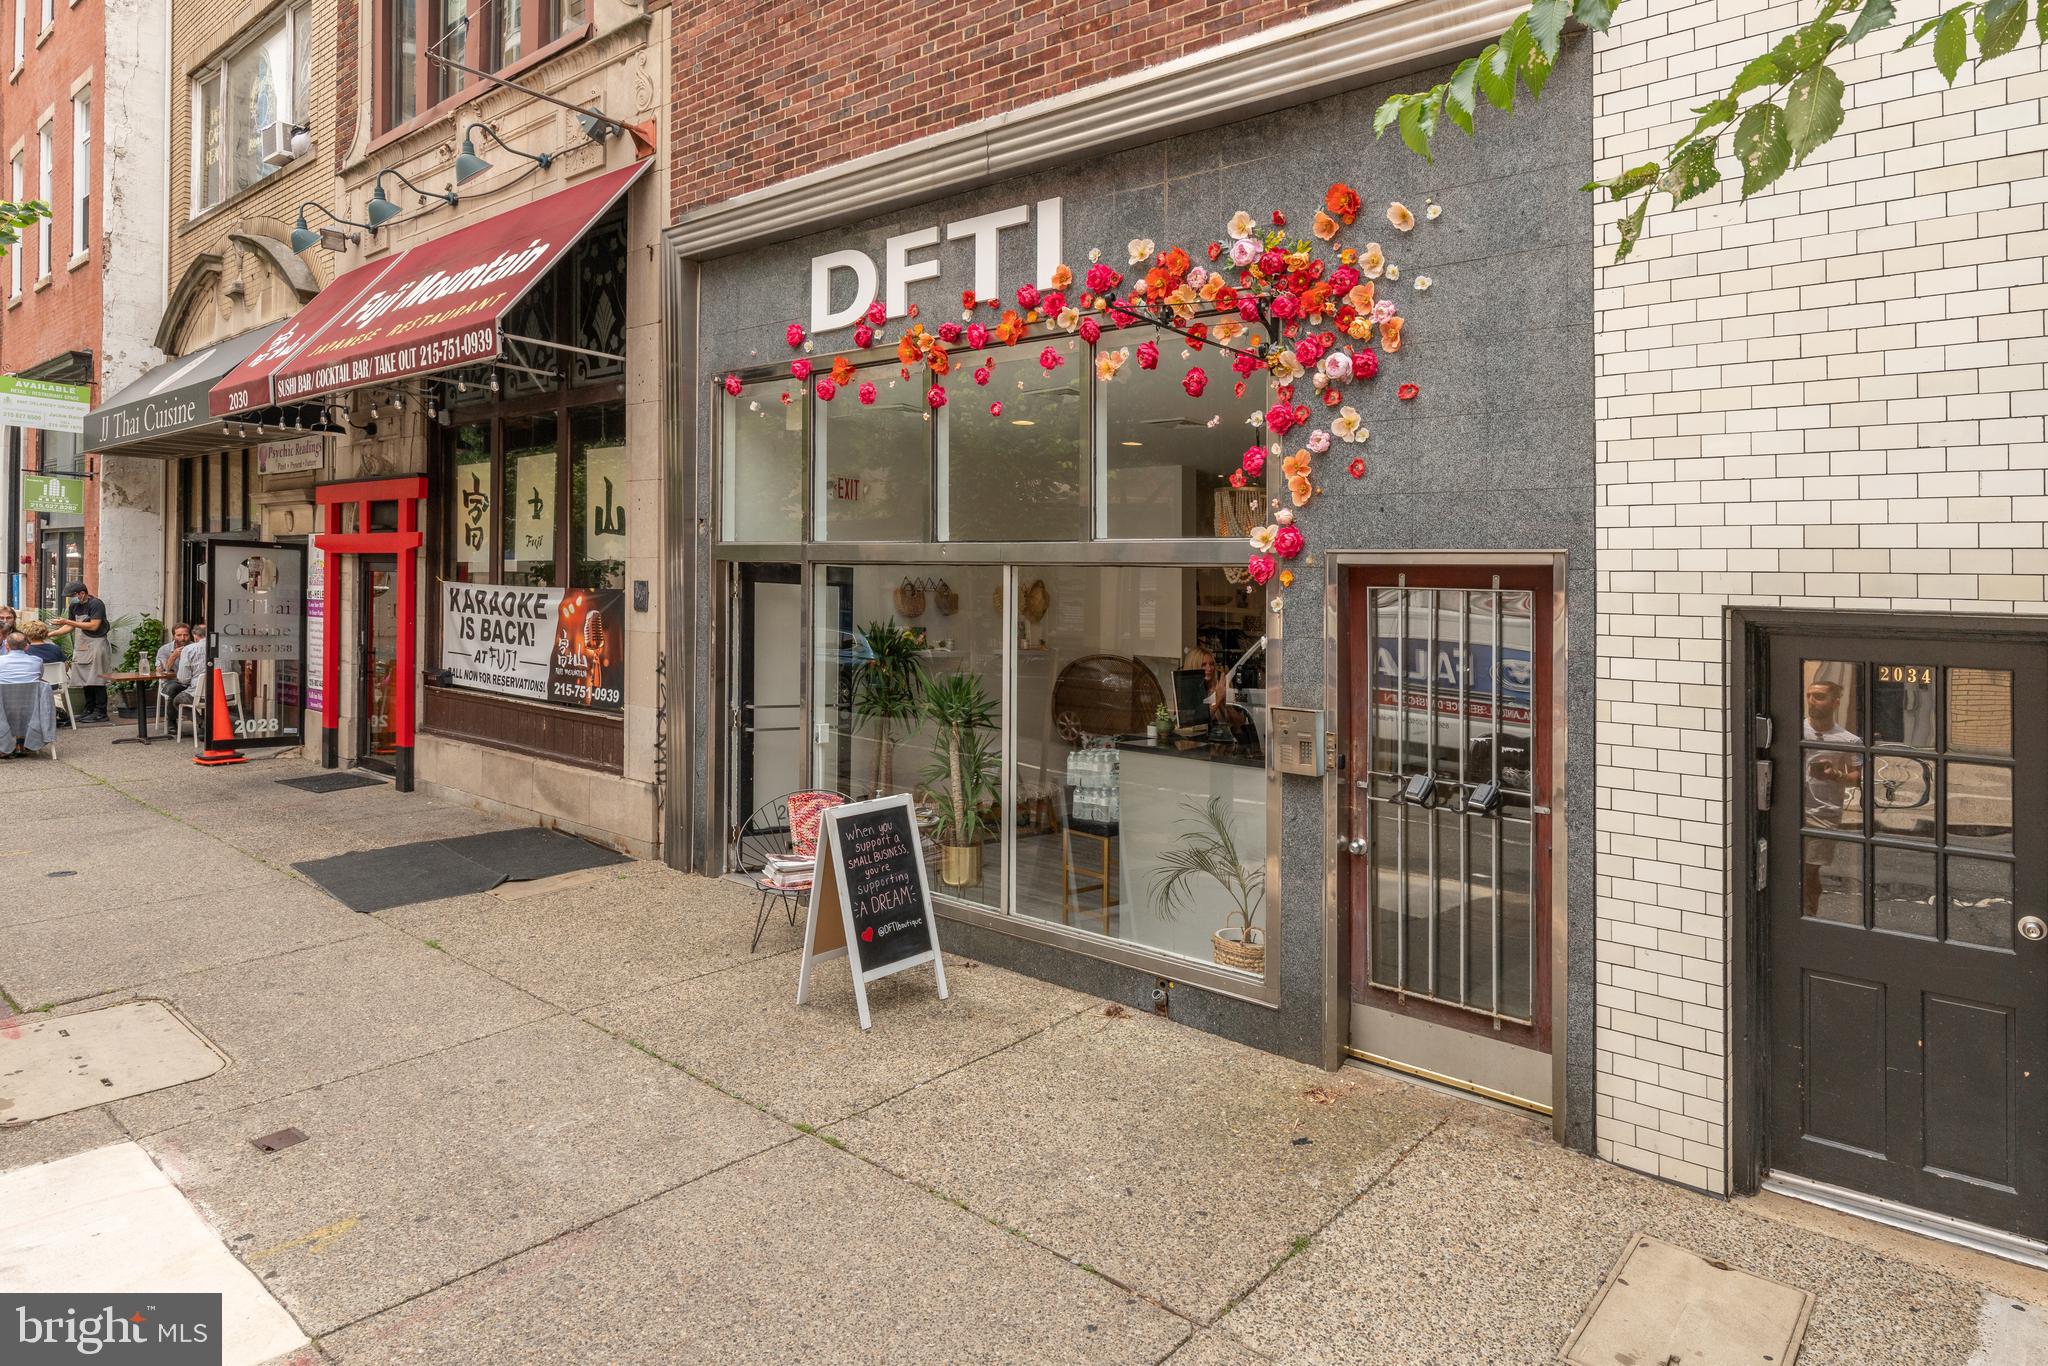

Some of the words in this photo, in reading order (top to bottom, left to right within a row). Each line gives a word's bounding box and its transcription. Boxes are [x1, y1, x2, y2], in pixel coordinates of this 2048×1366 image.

[811, 197, 1063, 334] DFTI
[341, 281, 416, 330] Fuji
[392, 239, 550, 312] Mountain
[307, 328, 382, 357] JAPANESE
[386, 292, 507, 337] RESTAURANT
[277, 376, 297, 397] SUSHI
[316, 363, 351, 388] COCKTAIL
[374, 352, 397, 376] TAKE
[398, 347, 417, 370] OUT
[420, 327, 493, 366] 215-751-0939
[15, 381, 77, 394] AVAILABLE
[229, 390, 249, 411] 2030
[99, 416, 109, 442] JJ
[113, 408, 140, 439] Thai
[144, 397, 196, 432] Cuisine
[268, 444, 294, 458] Psychic
[295, 439, 321, 457] Readings
[838, 477, 860, 501] EXIT
[525, 534, 544, 549] Fuji
[246, 598, 291, 615] Thai
[449, 588, 549, 620] KARAOKE
[223, 623, 291, 637] Cuisine
[460, 616, 475, 640] IS
[480, 618, 535, 647] BACK!
[474, 650, 488, 664] AT
[464, 670, 478, 682] NOW
[479, 672, 491, 684] FOR
[493, 674, 546, 693] RESERVATIONS!
[1880, 667, 1931, 684] 2034
[554, 682, 620, 703] 215-751-0939
[234, 718, 279, 734] 2028
[878, 822, 893, 836] you
[855, 834, 892, 853] support
[894, 834, 900, 843] a
[848, 854, 873, 869] SMALL
[865, 863, 891, 880] you're
[857, 873, 910, 895] supporting
[860, 901, 869, 918] A
[870, 886, 912, 914] DREAM
